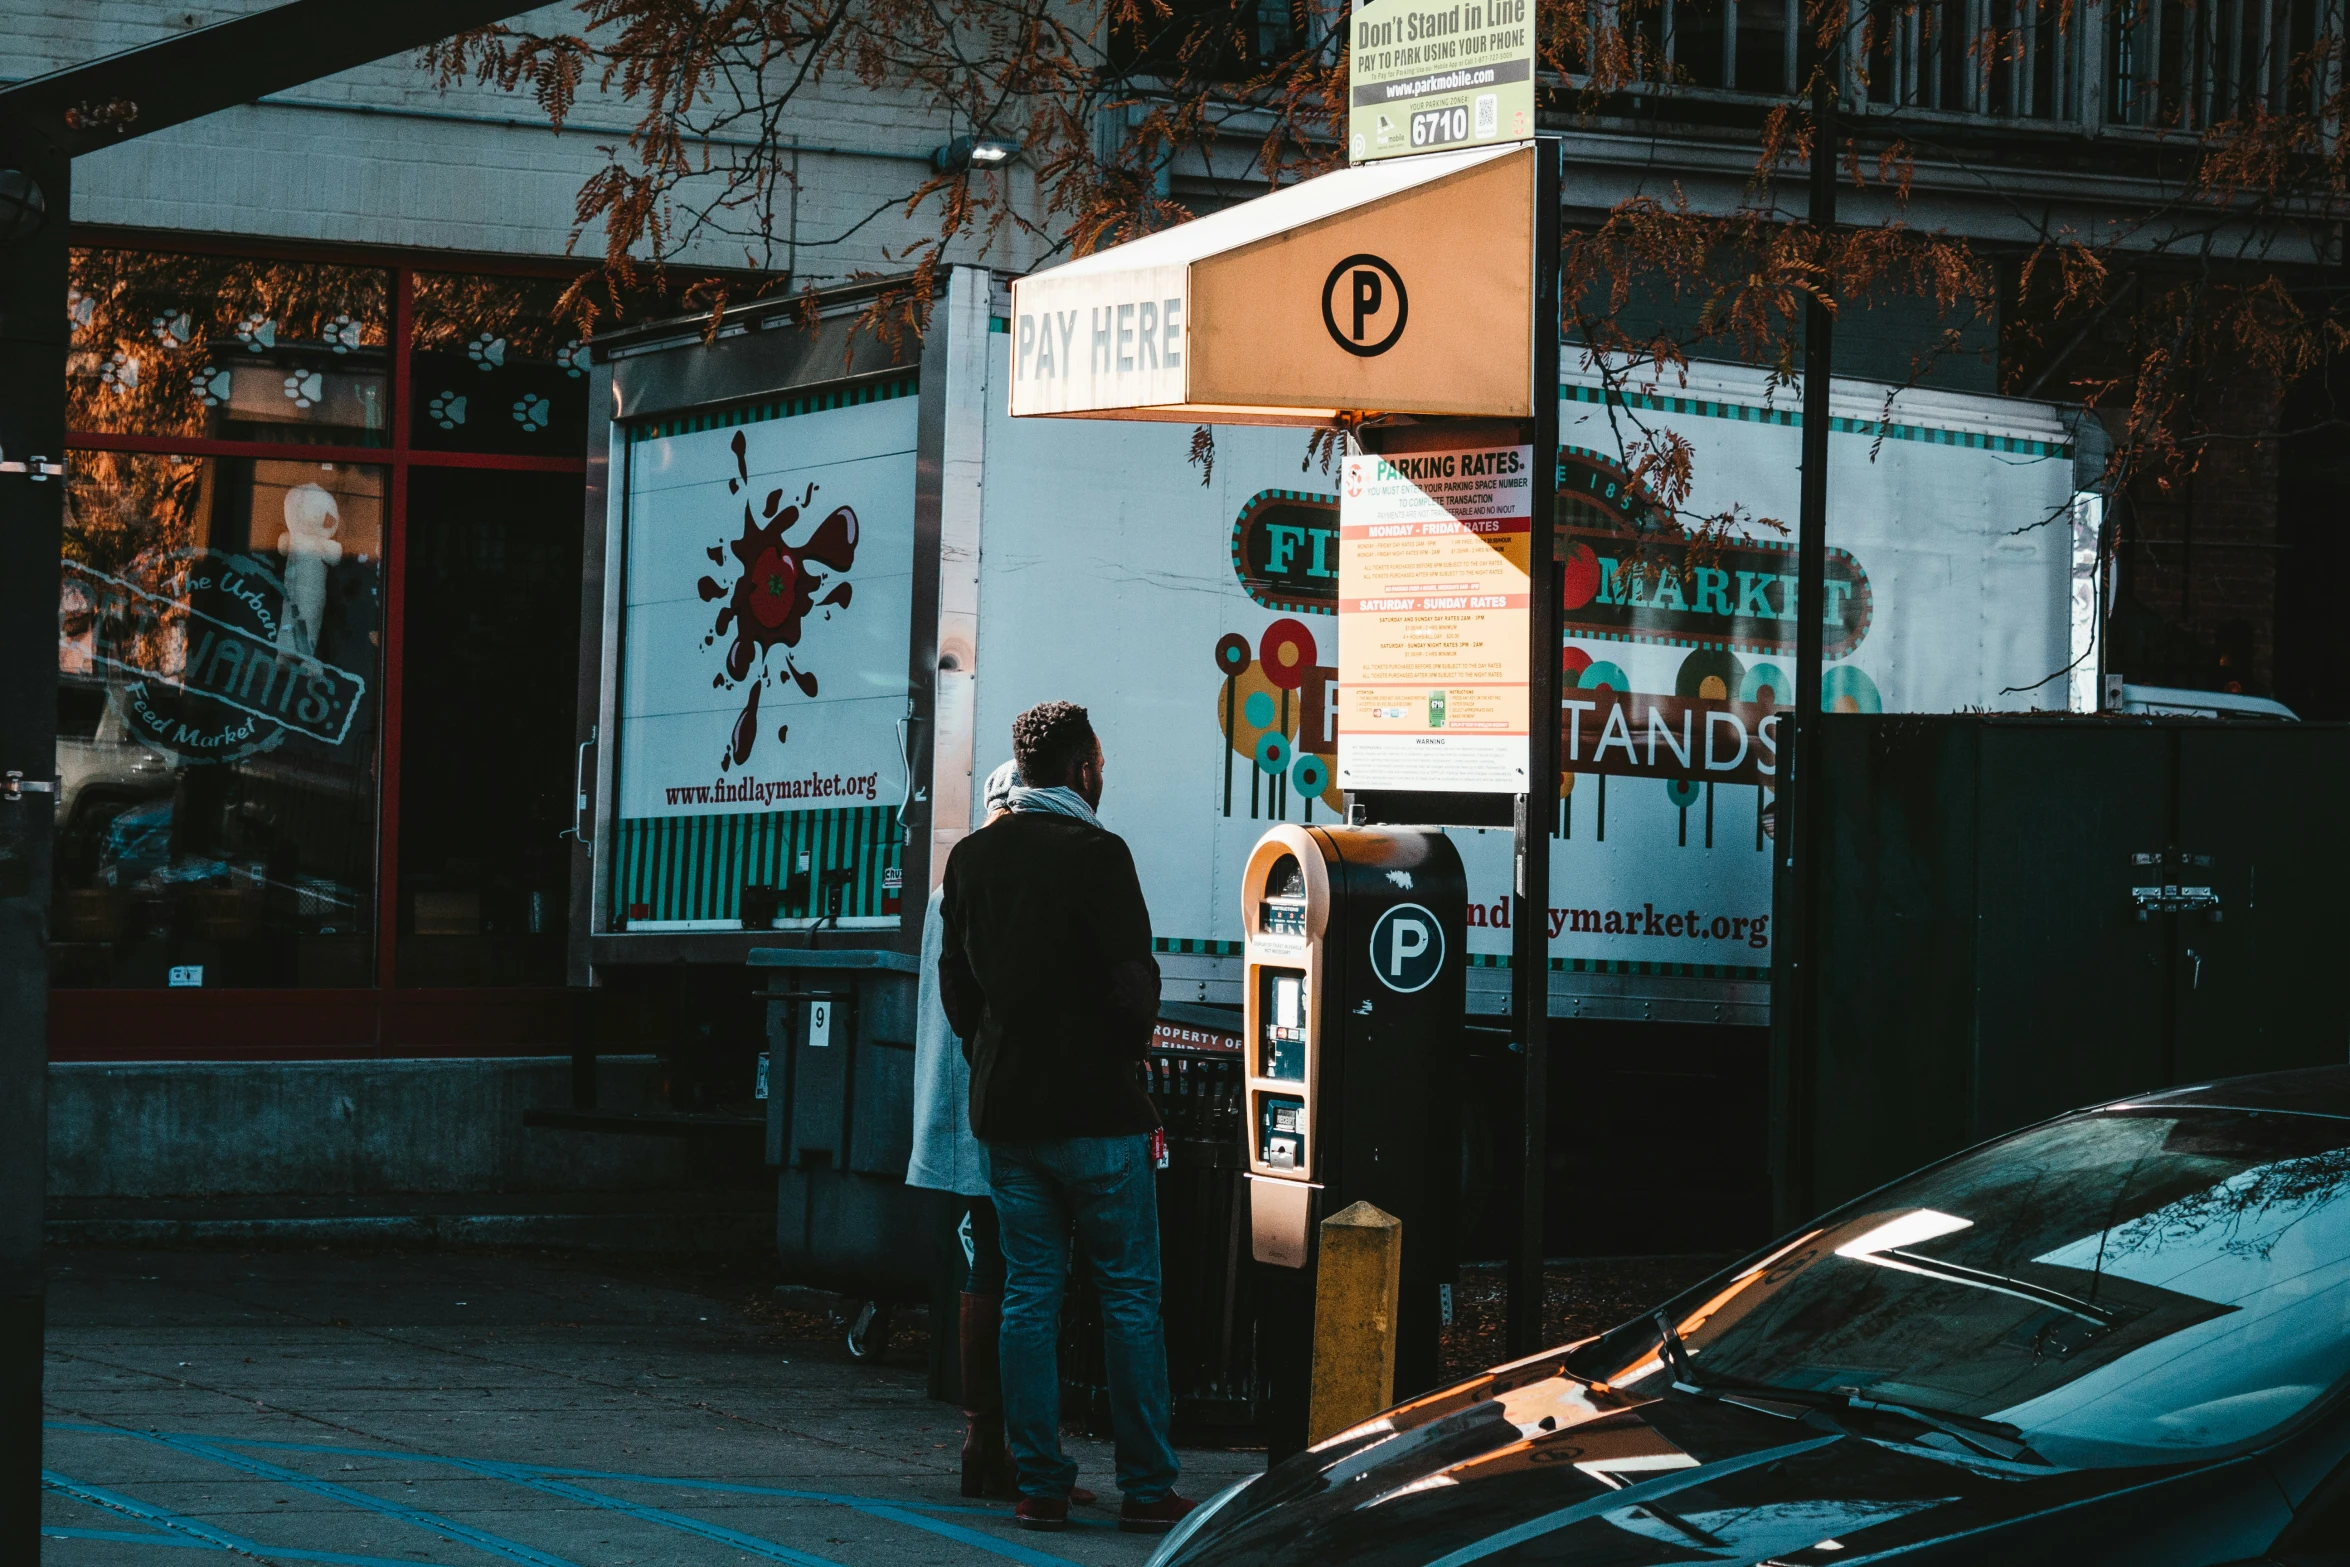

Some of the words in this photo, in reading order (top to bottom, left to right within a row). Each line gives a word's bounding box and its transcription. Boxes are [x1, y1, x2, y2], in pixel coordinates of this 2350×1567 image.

[1359, 16, 1402, 49] Don't
[1408, 5, 1459, 42] Stand
[1465, 3, 1481, 31] in
[1488, 0, 1525, 27] Line
[1358, 53, 1376, 72] PAY
[1379, 51, 1390, 69] TO
[1394, 47, 1420, 67] PARK
[1424, 42, 1455, 62] USING
[1459, 36, 1487, 56] YOUR
[1490, 29, 1524, 49] PHONE
[1434, 62, 1448, 71] Mobile
[1387, 69, 1494, 98] www.parkmobile.com
[1410, 100, 1424, 111] YOUR
[1425, 97, 1449, 109] PARKING
[1413, 108, 1467, 145] 6710
[1353, 270, 1382, 340] P
[1018, 310, 1078, 381] PAY
[1091, 298, 1181, 374] HERE
[1377, 456, 1455, 481] PARKING
[1461, 452, 1519, 477] RATES
[1367, 487, 1380, 496] YOU
[1382, 486, 1399, 495] MUST
[1401, 484, 1422, 494] ENTER
[1424, 483, 1442, 493] YOUR
[1444, 481, 1472, 492] PARKING
[1475, 480, 1496, 490] SPACE
[1499, 478, 1528, 489] NUMBER
[1400, 498, 1407, 508] TO
[1409, 496, 1443, 507] COMPLETE
[1446, 494, 1492, 506] TRANSACTION
[1369, 525, 1412, 537] MONDAY
[1423, 523, 1459, 534] FRIDAY
[1462, 521, 1499, 532] RATES
[161, 571, 212, 598] The
[220, 572, 279, 640] Urban
[1360, 599, 1413, 611] SATURDAY
[1424, 597, 1467, 609] SUNDAY
[1470, 596, 1506, 608] RATES
[125, 680, 174, 734] Feed
[172, 716, 258, 748] Market
[666, 772, 877, 806] www.findlaymarket.org
[1391, 918, 1429, 976] P
[816, 1007, 824, 1028] 9
[1154, 1025, 1218, 1045] ROPERTY
[1225, 1038, 1242, 1049] OF
